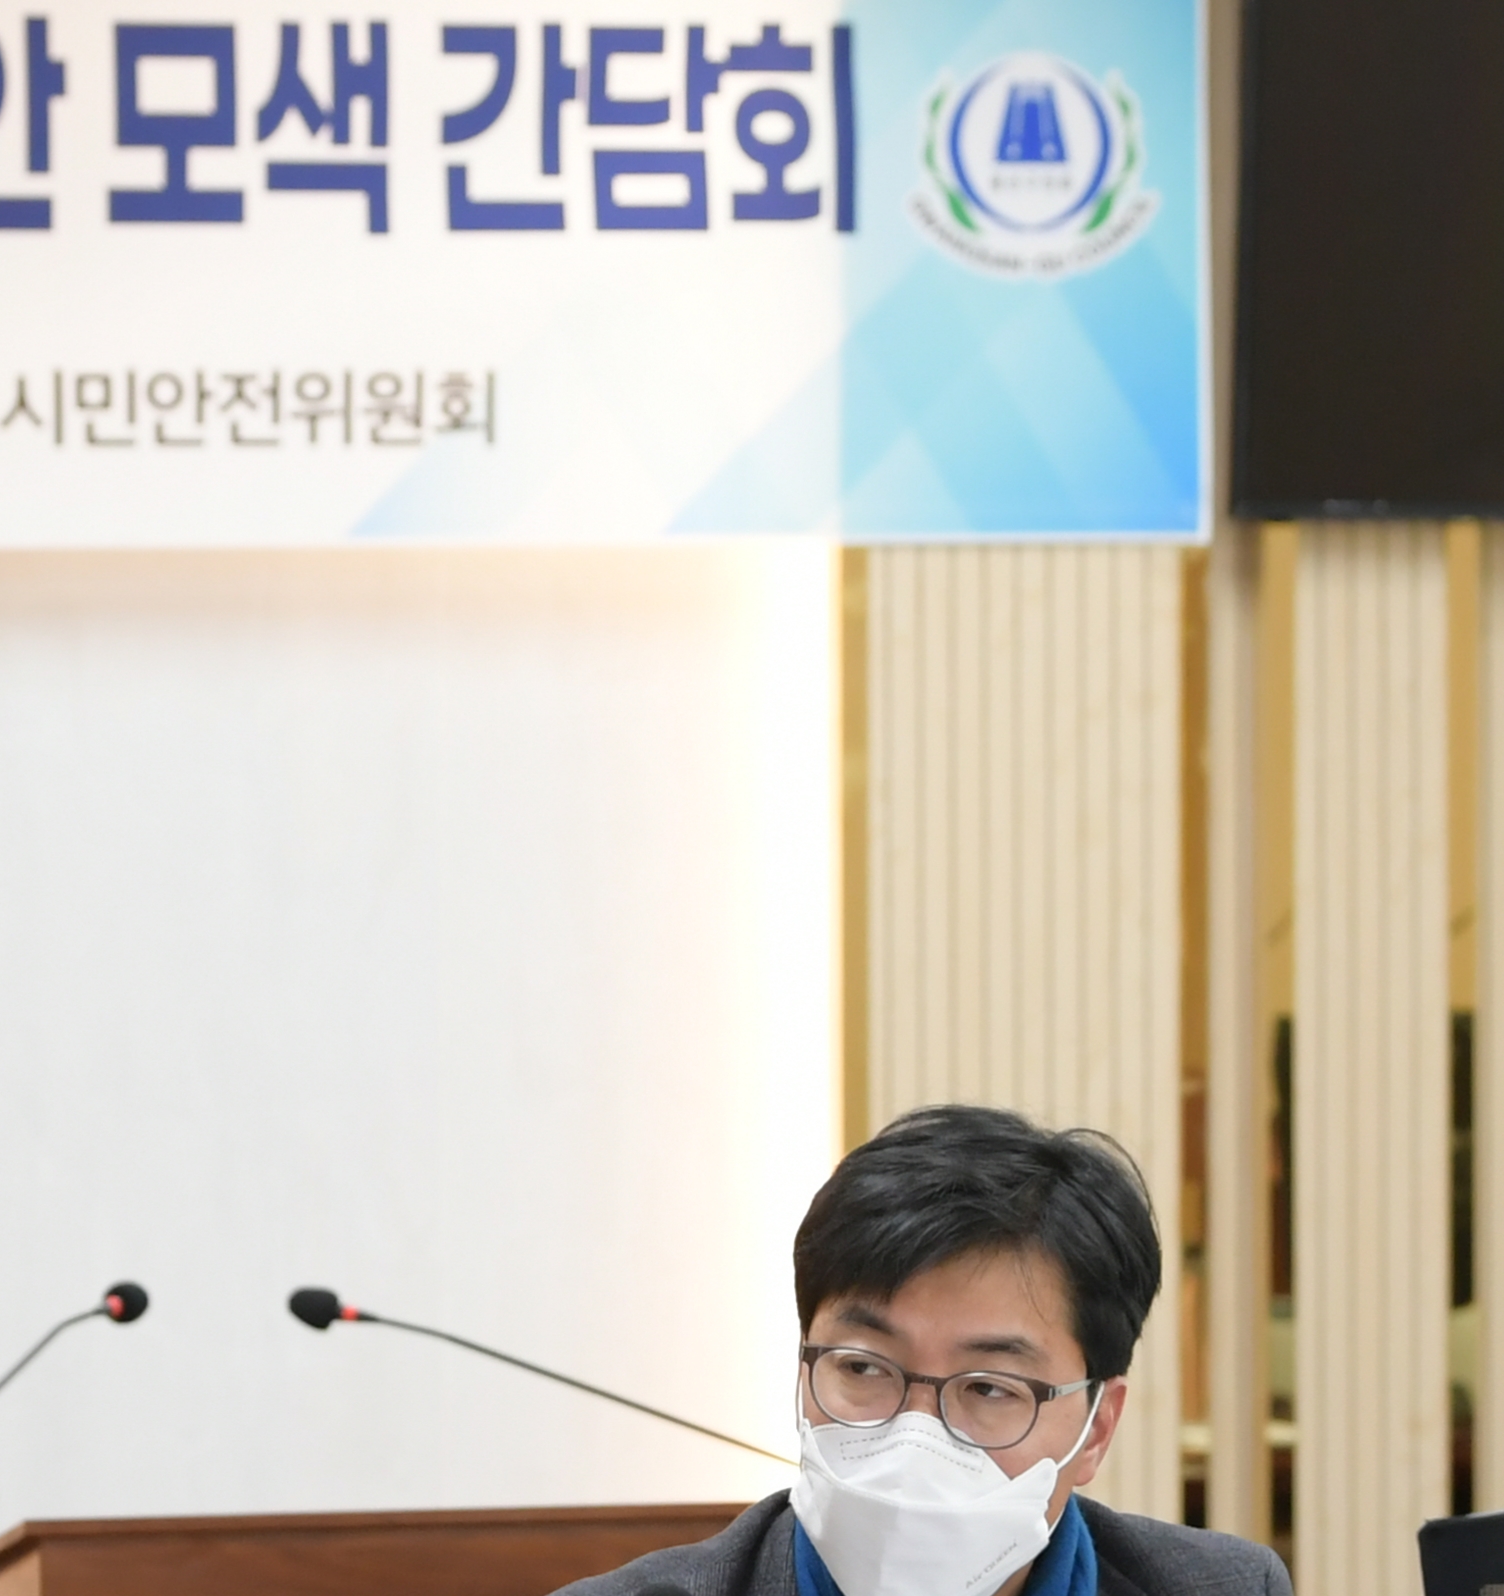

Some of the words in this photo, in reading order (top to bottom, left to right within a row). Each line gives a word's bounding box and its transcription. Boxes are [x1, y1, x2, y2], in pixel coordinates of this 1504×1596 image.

[108, 21, 390, 234] 모색
[441, 20, 859, 235] 간담회
[1, 370, 496, 448] 시민안전위원회
